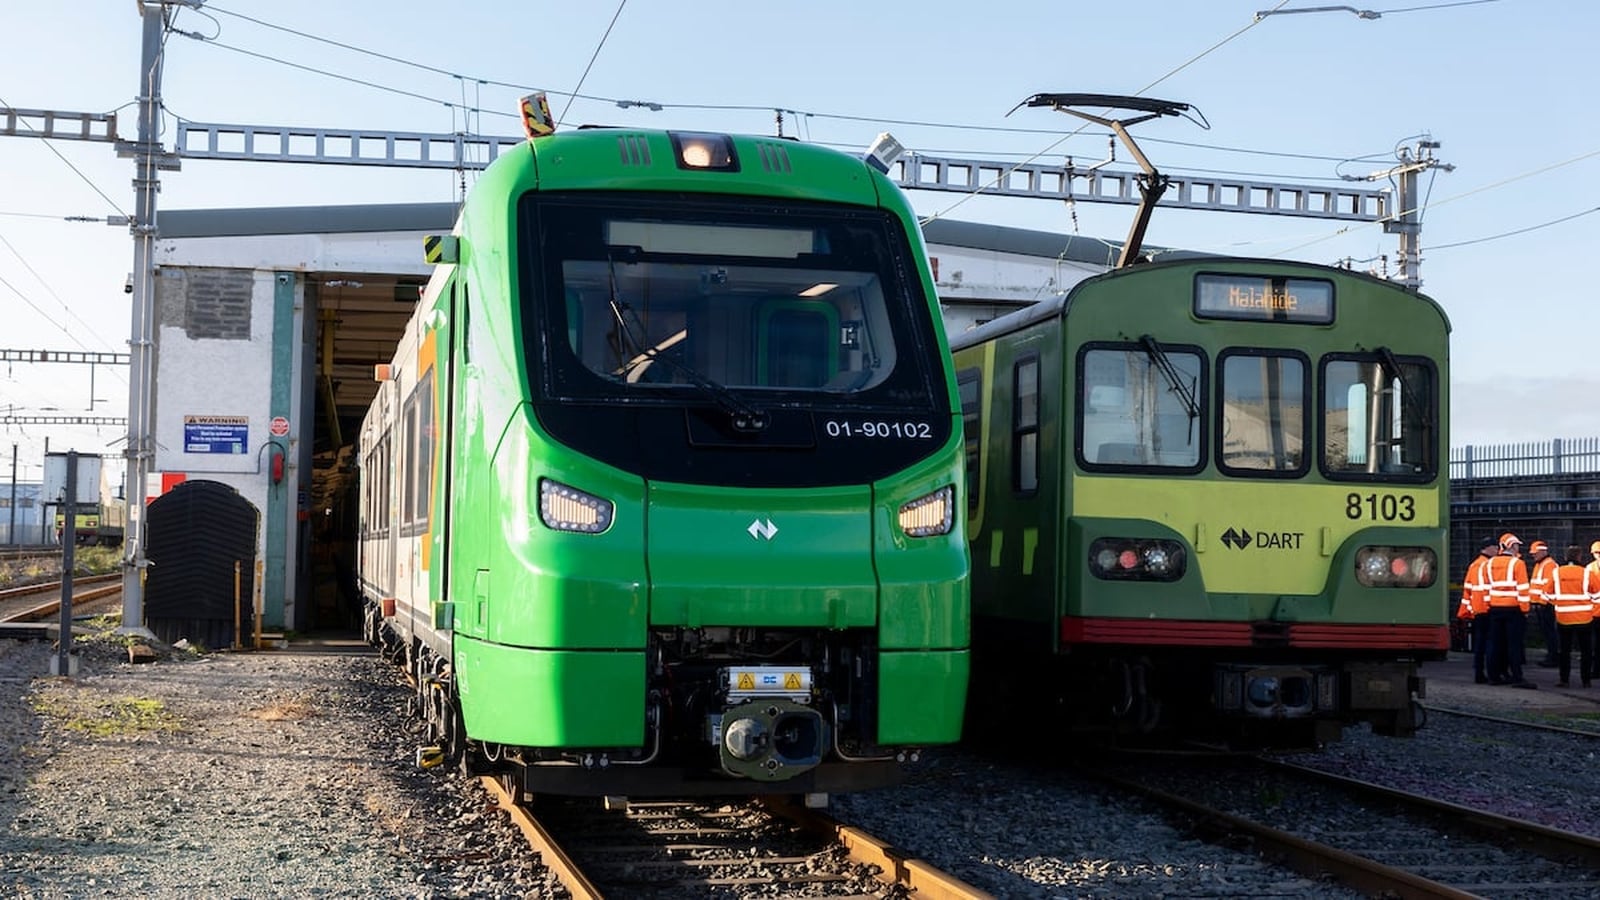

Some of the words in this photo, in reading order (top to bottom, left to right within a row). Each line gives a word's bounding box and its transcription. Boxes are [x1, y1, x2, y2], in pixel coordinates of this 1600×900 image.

[1228, 287, 1298, 310] Malahide
[826, 421, 932, 438] 01-90102
[1345, 493, 1416, 521] 8103
[1256, 532, 1304, 549] DART
[763, 676, 777, 684] DC
